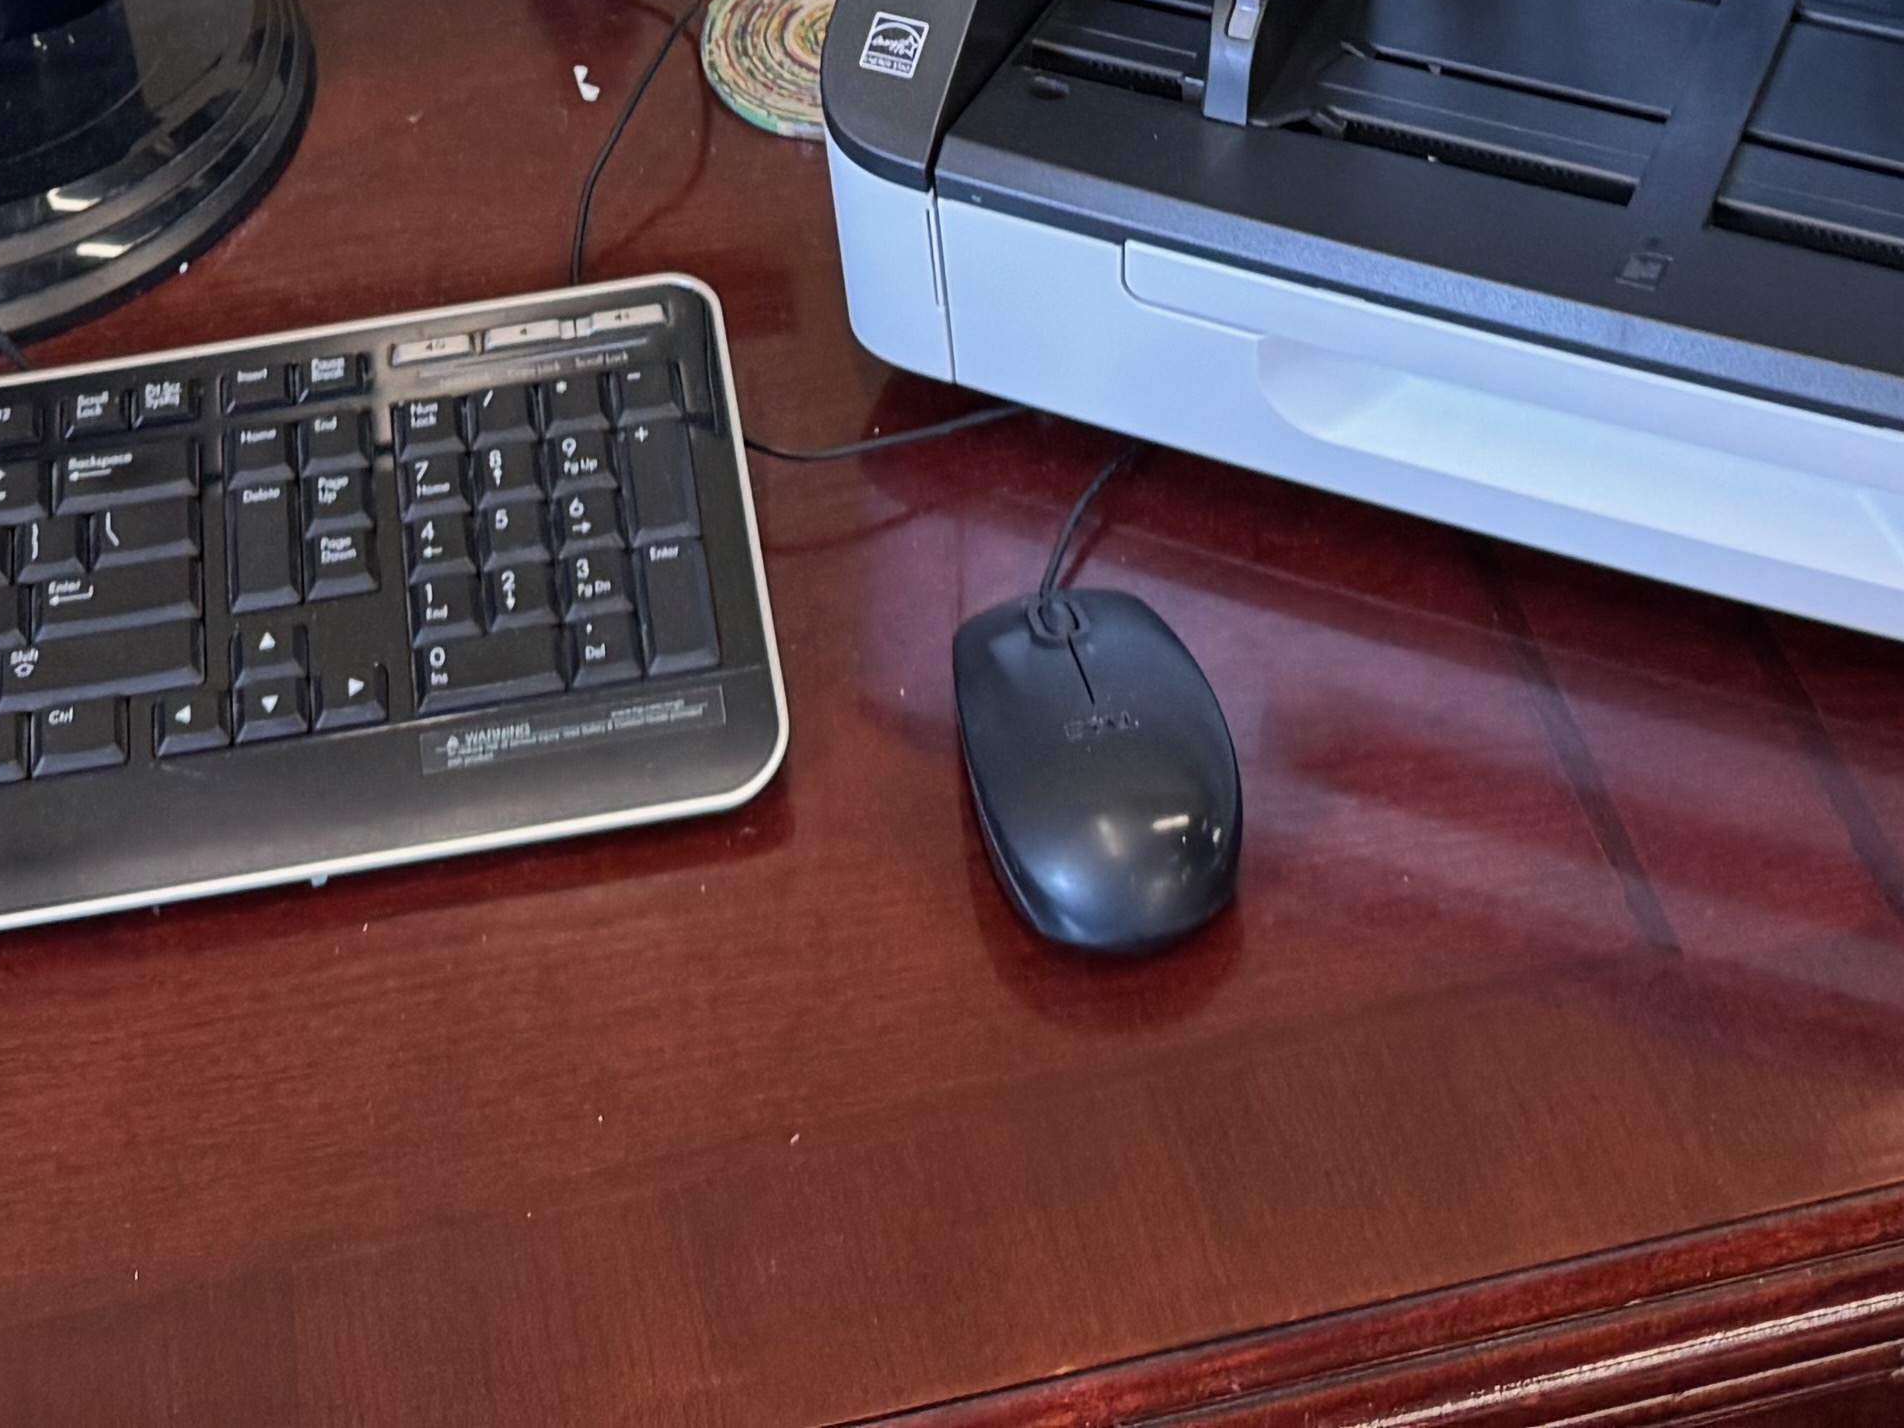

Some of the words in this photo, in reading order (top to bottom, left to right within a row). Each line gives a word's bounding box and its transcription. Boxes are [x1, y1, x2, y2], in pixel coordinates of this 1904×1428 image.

[561, 437, 577, 458] 9
[488, 448, 503, 470] 8
[580, 456, 599, 474] Up
[414, 460, 430, 482] 7
[242, 487, 281, 505] Delete
[317, 488, 338, 505] Up
[495, 507, 509, 530] 5
[568, 497, 585, 519] 6
[420, 521, 435, 543] 4
[576, 557, 590, 580] 3
[47, 579, 82, 596] Enter
[500, 569, 516, 591] 2
[424, 582, 434, 605] 1
[584, 643, 606, 661] Del
[47, 704, 75, 726] Ctrl
